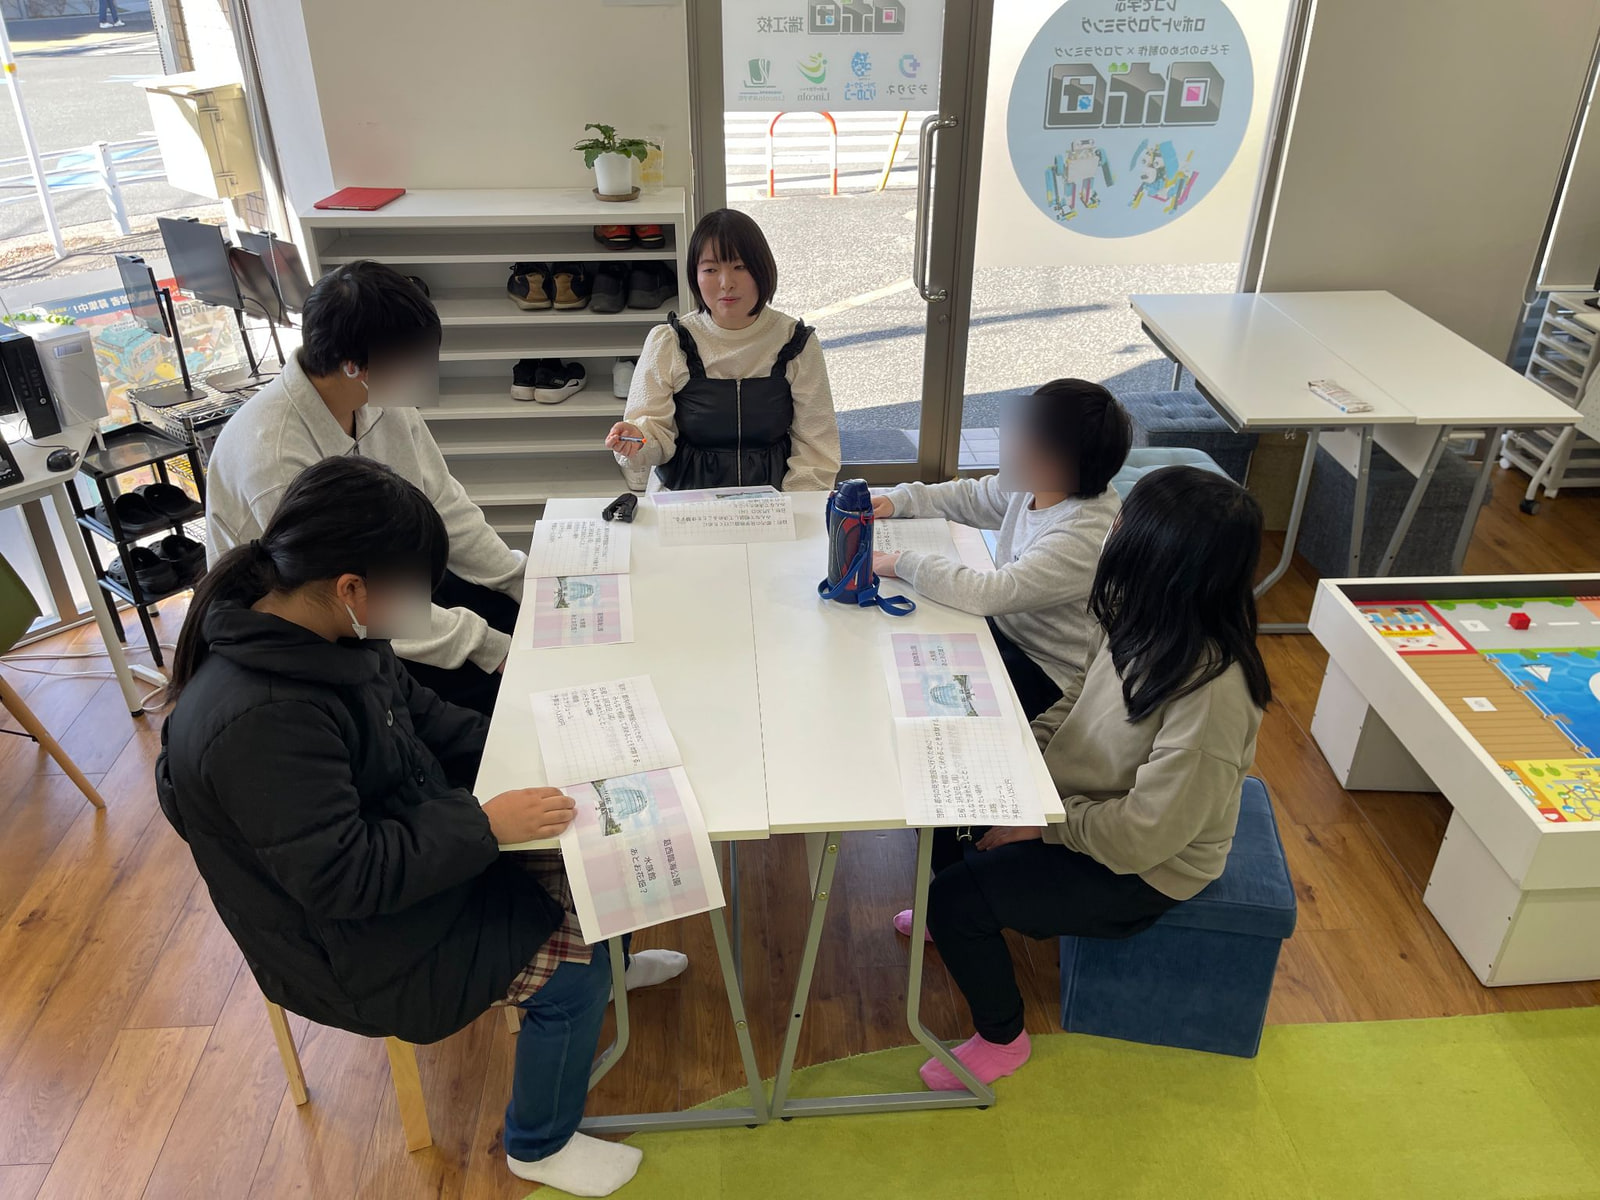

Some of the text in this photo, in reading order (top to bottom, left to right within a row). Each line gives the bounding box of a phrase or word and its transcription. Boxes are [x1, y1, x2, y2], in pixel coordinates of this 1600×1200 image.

[644, 856, 656, 881] 水族館
[663, 839, 681, 886] 葛西臨海公園
